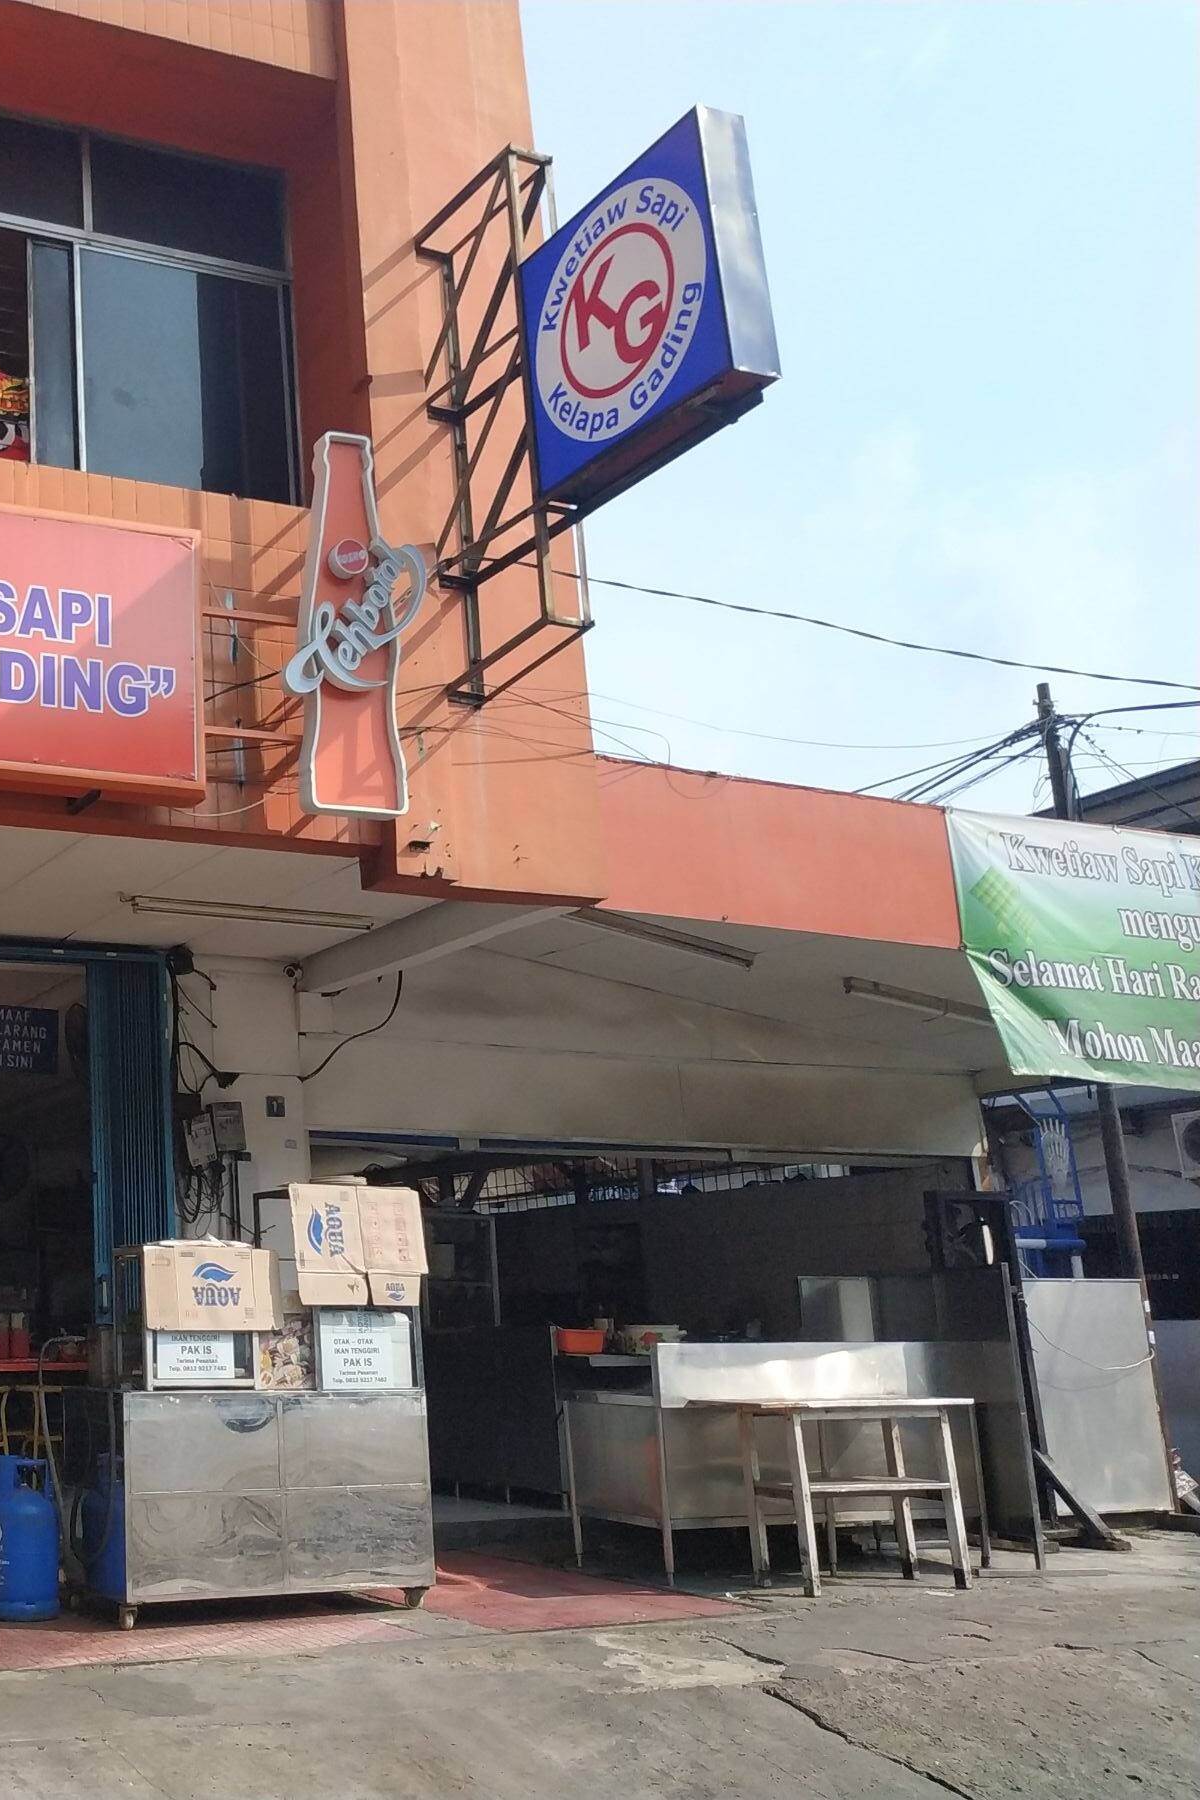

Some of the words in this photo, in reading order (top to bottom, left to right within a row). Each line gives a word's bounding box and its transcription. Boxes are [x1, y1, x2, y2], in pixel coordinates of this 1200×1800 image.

[543, 197, 627, 332] Kwetiaw
[635, 185, 689, 232] Sapi
[571, 254, 665, 364] KG
[548, 382, 619, 439] Kelapa
[630, 282, 702, 411] Gading
[1000, 832, 1119, 883] Kwetiaw
[1121, 847, 1184, 898] Sapi
[988, 949, 1105, 993] Selamat
[1104, 957, 1167, 998] Hari
[7, 1055, 33, 1068] SINI
[1042, 1018, 1150, 1063] Mohon
[324, 1202, 345, 1258] AQUA
[192, 1283, 241, 1307] AQUA
[385, 1282, 405, 1293] AQUA
[171, 1334, 187, 1342] IKAN
[180, 1345, 200, 1355] PAK
[203, 1345, 212, 1355] IS
[343, 1358, 362, 1367] PAK
[364, 1357, 373, 1367] IS
